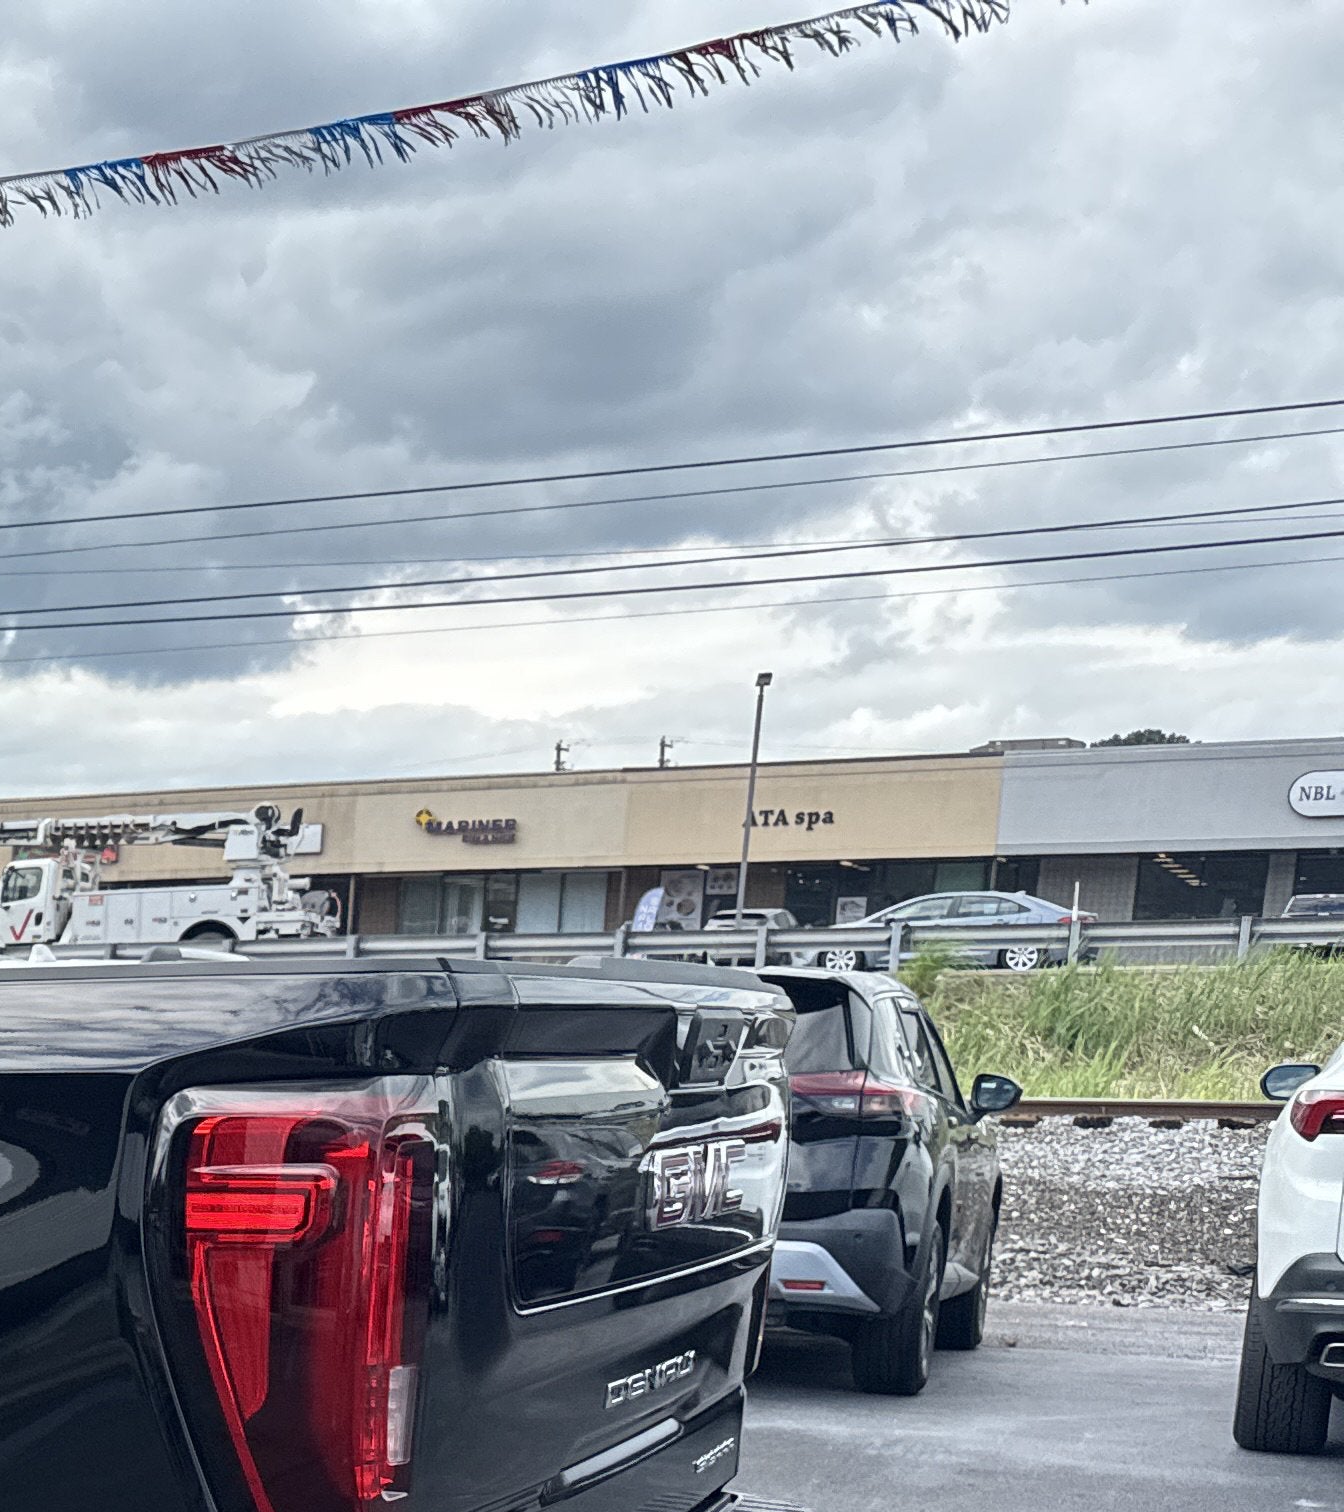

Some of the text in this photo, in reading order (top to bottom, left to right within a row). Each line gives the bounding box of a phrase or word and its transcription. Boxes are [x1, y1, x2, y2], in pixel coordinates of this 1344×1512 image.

[1298, 786, 1336, 801] NBL
[425, 818, 517, 835] MARINER
[795, 810, 834, 831] spa
[648, 1139, 746, 1232] GMC
